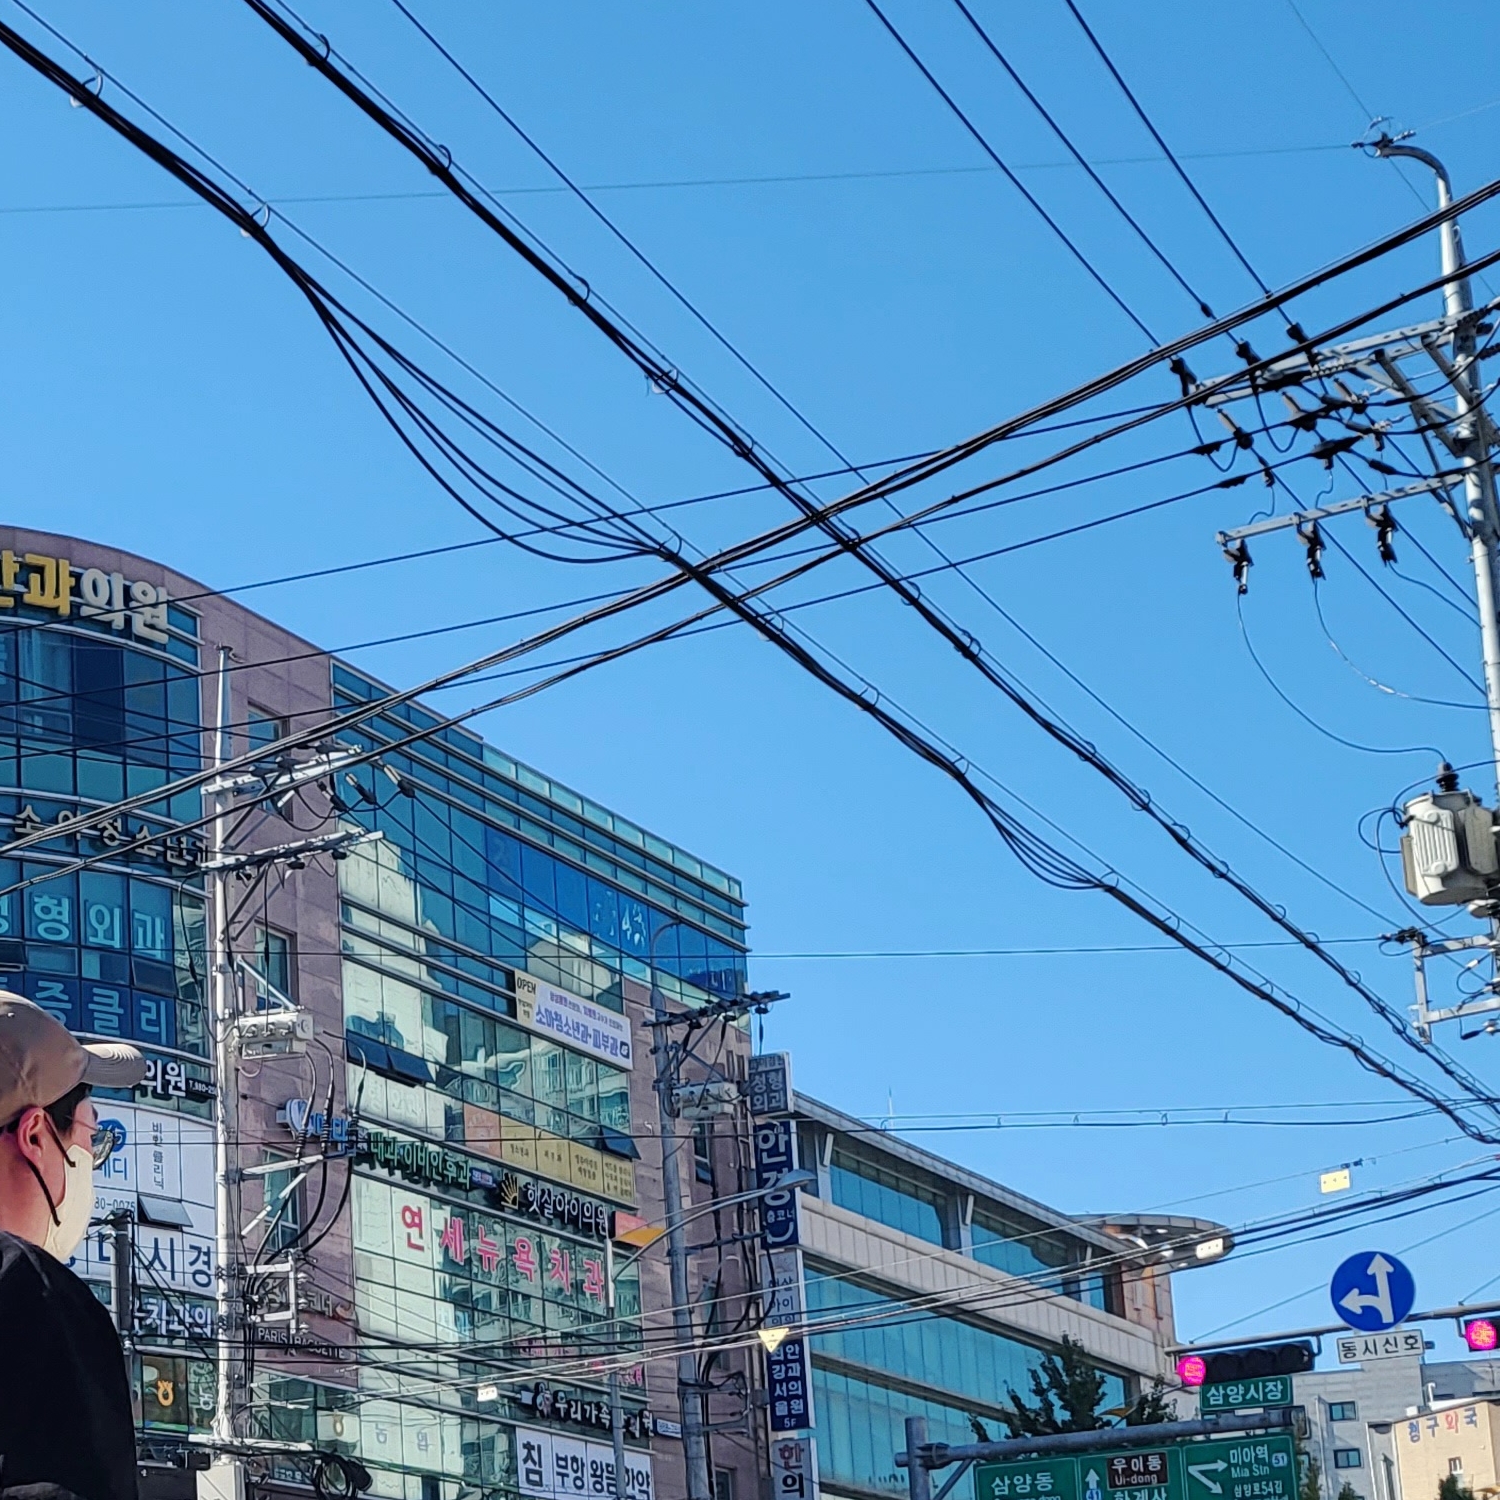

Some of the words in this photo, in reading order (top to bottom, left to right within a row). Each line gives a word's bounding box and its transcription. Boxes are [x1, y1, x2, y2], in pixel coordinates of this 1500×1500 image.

[516, 976, 537, 996] OPEN
[757, 1127, 792, 1207] 안경
[401, 1204, 604, 1303] 연세뉴욕치과
[257, 1327, 288, 1344] PARIS
[1341, 1334, 1421, 1360] 동시신호
[1206, 1380, 1284, 1406] 삼양시장
[521, 1440, 544, 1488] 침
[555, 1451, 586, 1491] 부항
[1111, 1454, 1163, 1473] 우이동
[1229, 1443, 1269, 1466] 미아역
[1273, 1454, 1286, 1466] 51
[1114, 1471, 1158, 1487] Ui-dong
[1230, 1466, 1250, 1479] Mia
[1252, 1463, 1270, 1477] Stn
[990, 1471, 1055, 1496] 삼양동
